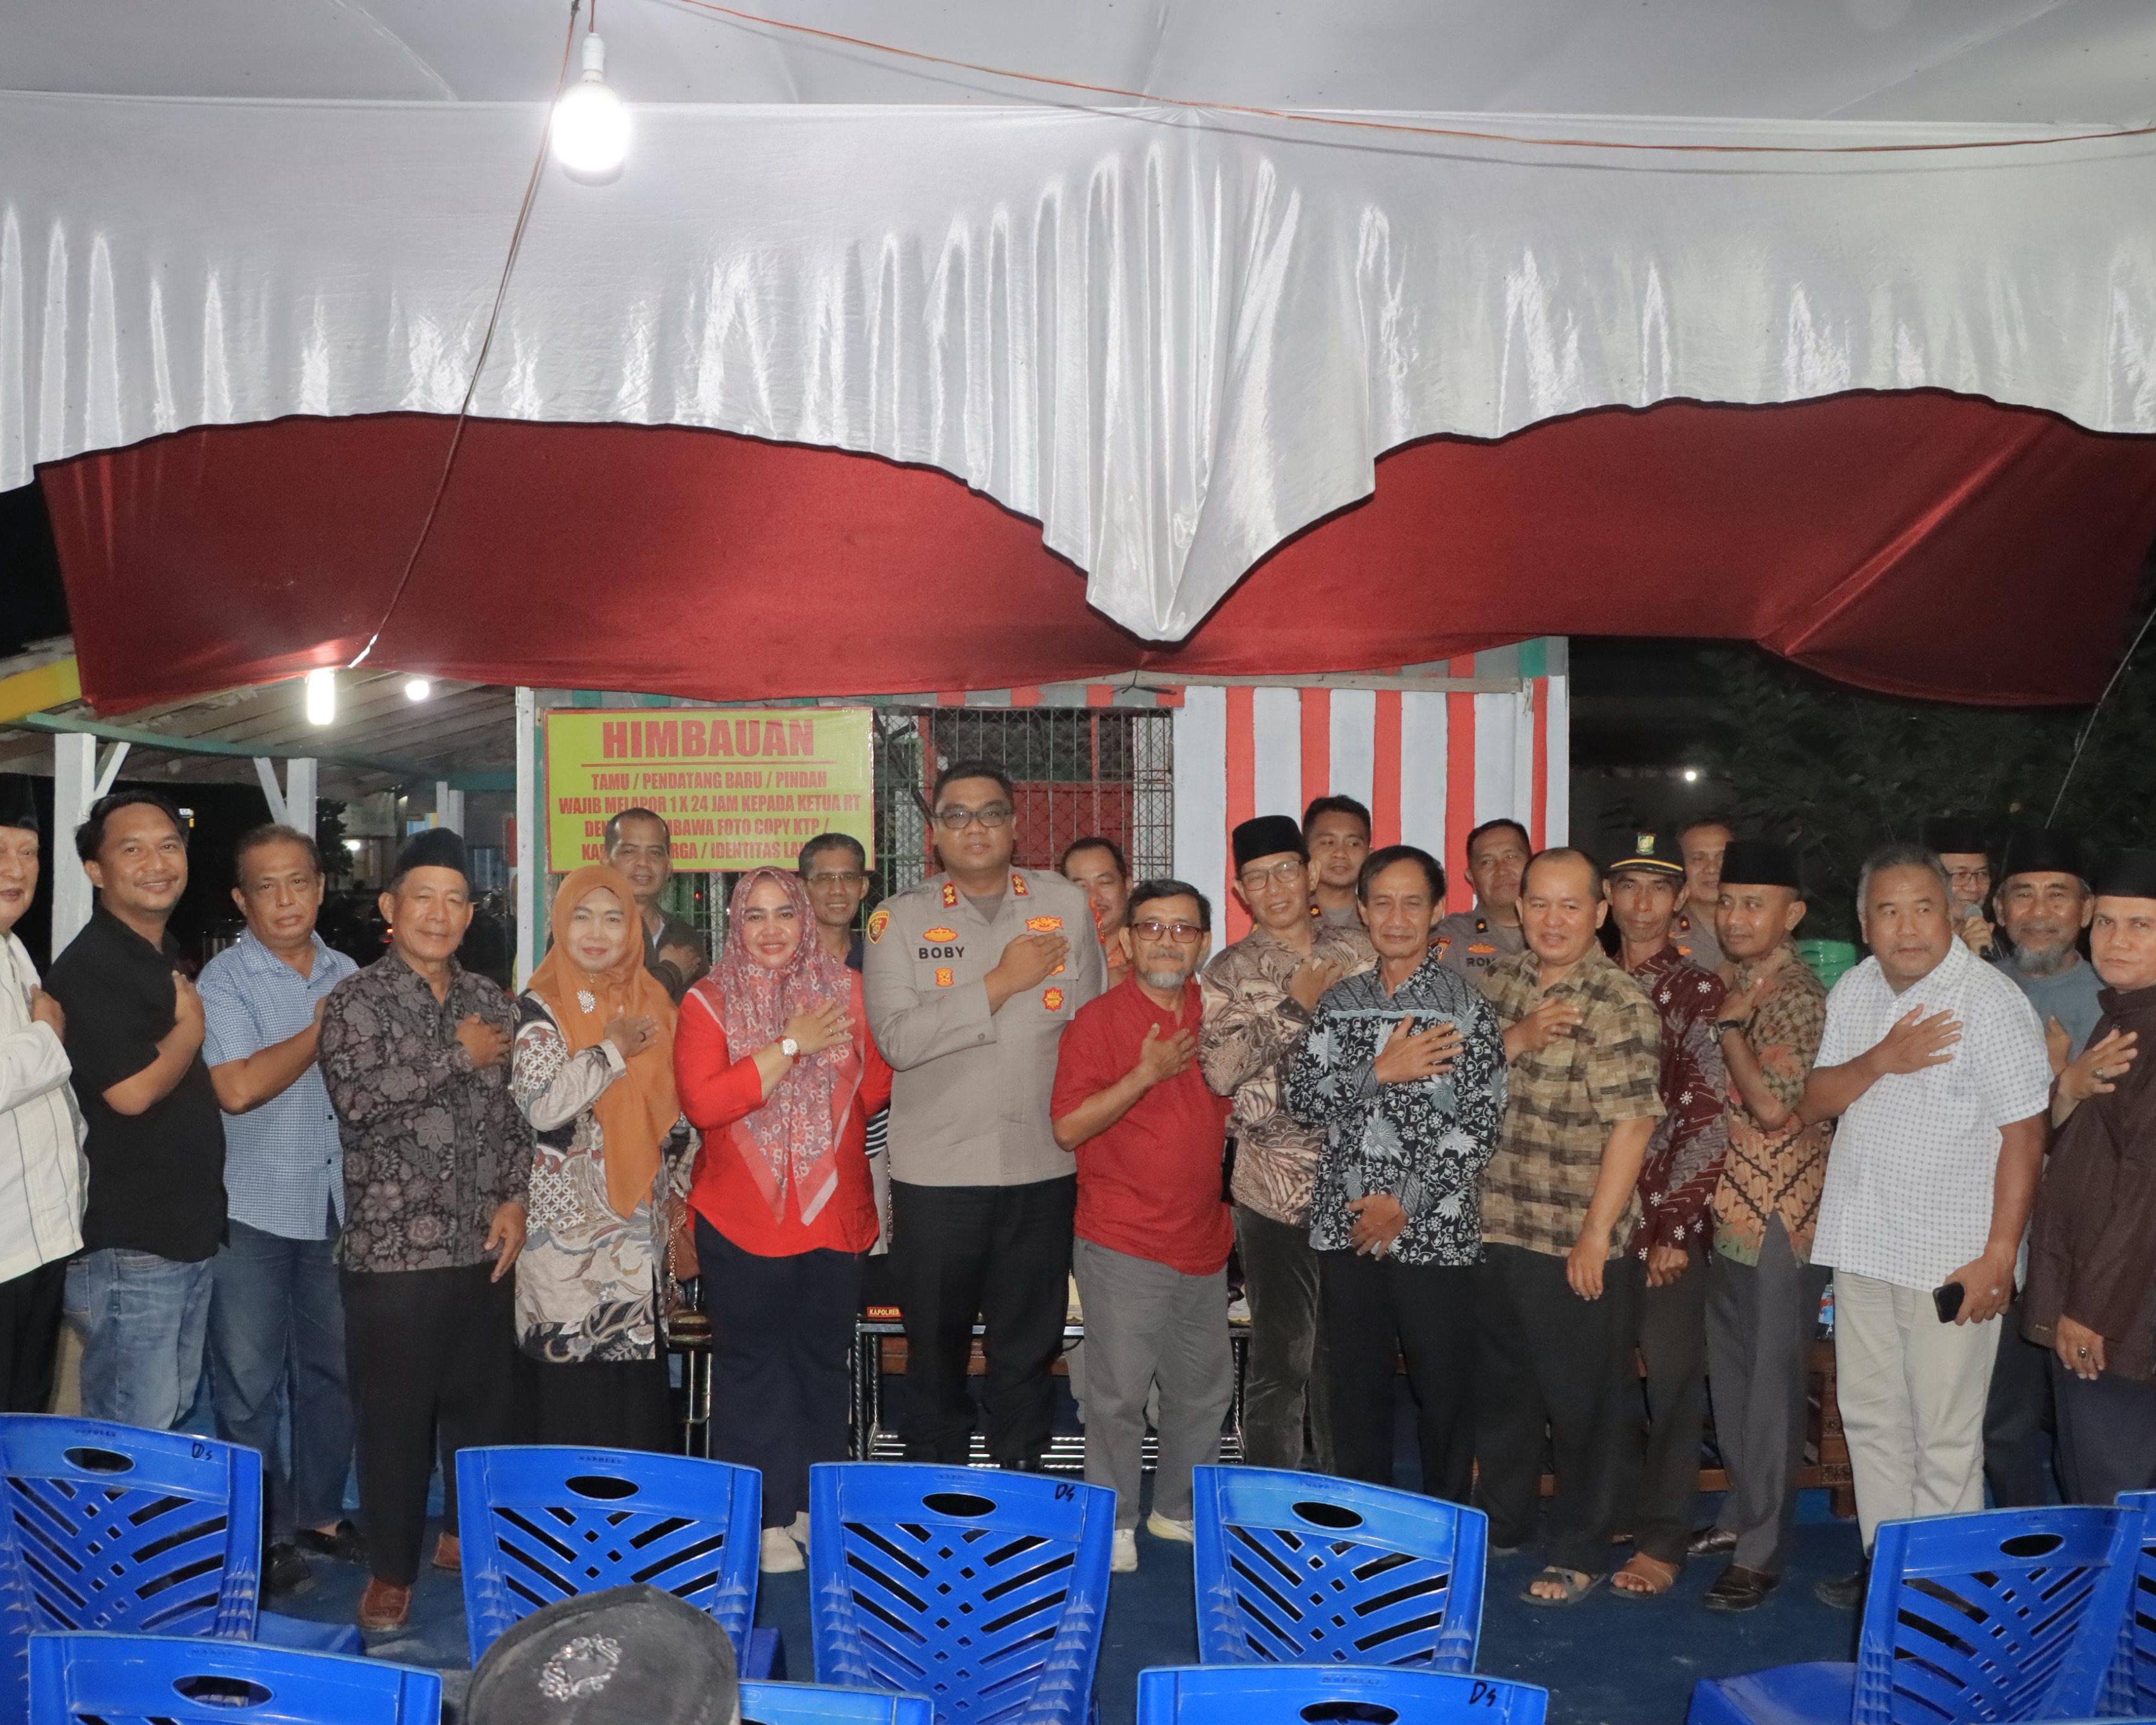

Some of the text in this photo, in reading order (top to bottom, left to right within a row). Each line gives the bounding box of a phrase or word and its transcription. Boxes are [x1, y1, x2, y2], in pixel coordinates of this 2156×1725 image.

[603, 719, 814, 759] HIMBAUAN
[592, 771, 827, 790] TAMU / PENDATANG BARU / PINDAH
[558, 793, 861, 814] WAJIB MELAPOR 1 X 24 JAM KEPADA KETUA RT
[718, 819, 751, 836] FOTO
[754, 818, 790, 835] COPY
[793, 817, 820, 835] KTP
[701, 842, 708, 859] /
[711, 841, 781, 859] IDENTITAS
[918, 946, 965, 959] BOBY
